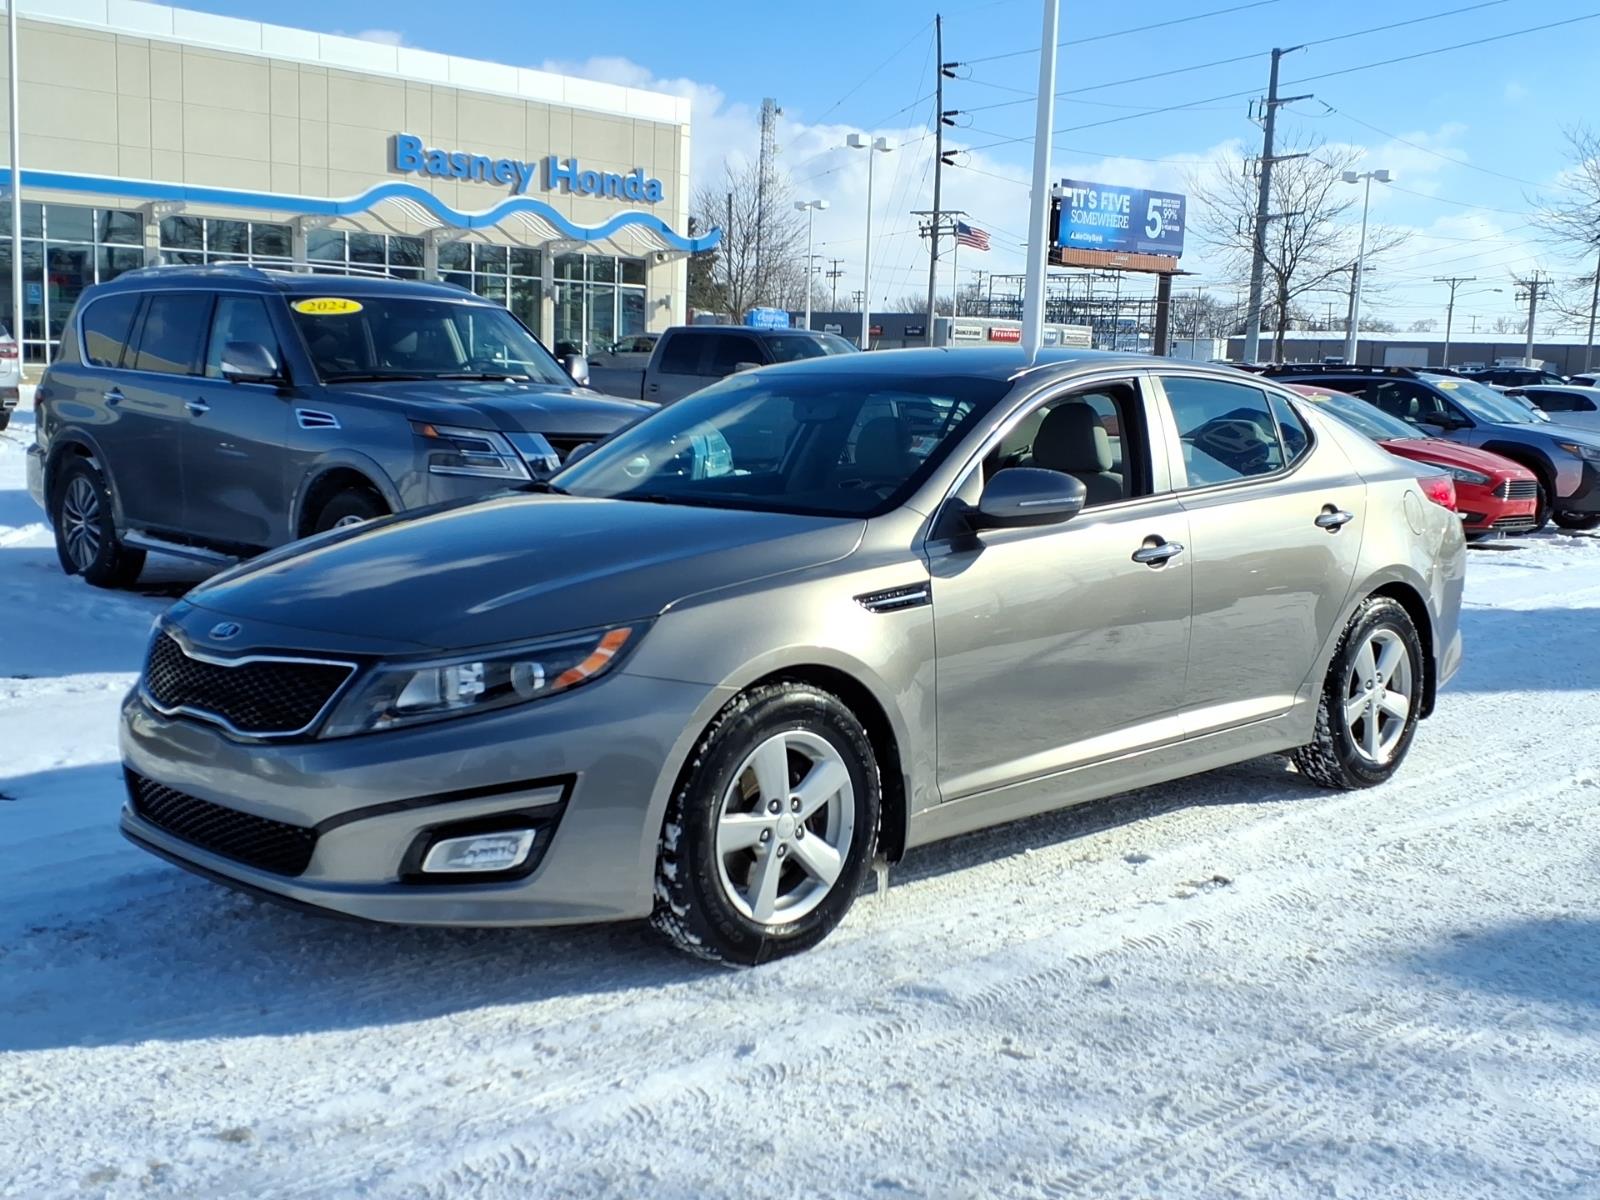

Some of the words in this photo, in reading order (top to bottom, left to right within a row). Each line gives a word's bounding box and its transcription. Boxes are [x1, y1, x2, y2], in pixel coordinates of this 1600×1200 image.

[388, 132, 536, 195] Basney
[541, 155, 665, 203] Honda
[1071, 188, 1098, 210] IT'S
[1100, 191, 1131, 214] FIVE
[1071, 209, 1130, 229] SOMEWHERE
[1145, 197, 1162, 239] 5
[307, 301, 348, 312] 2024
[992, 330, 1020, 338] Firestone
